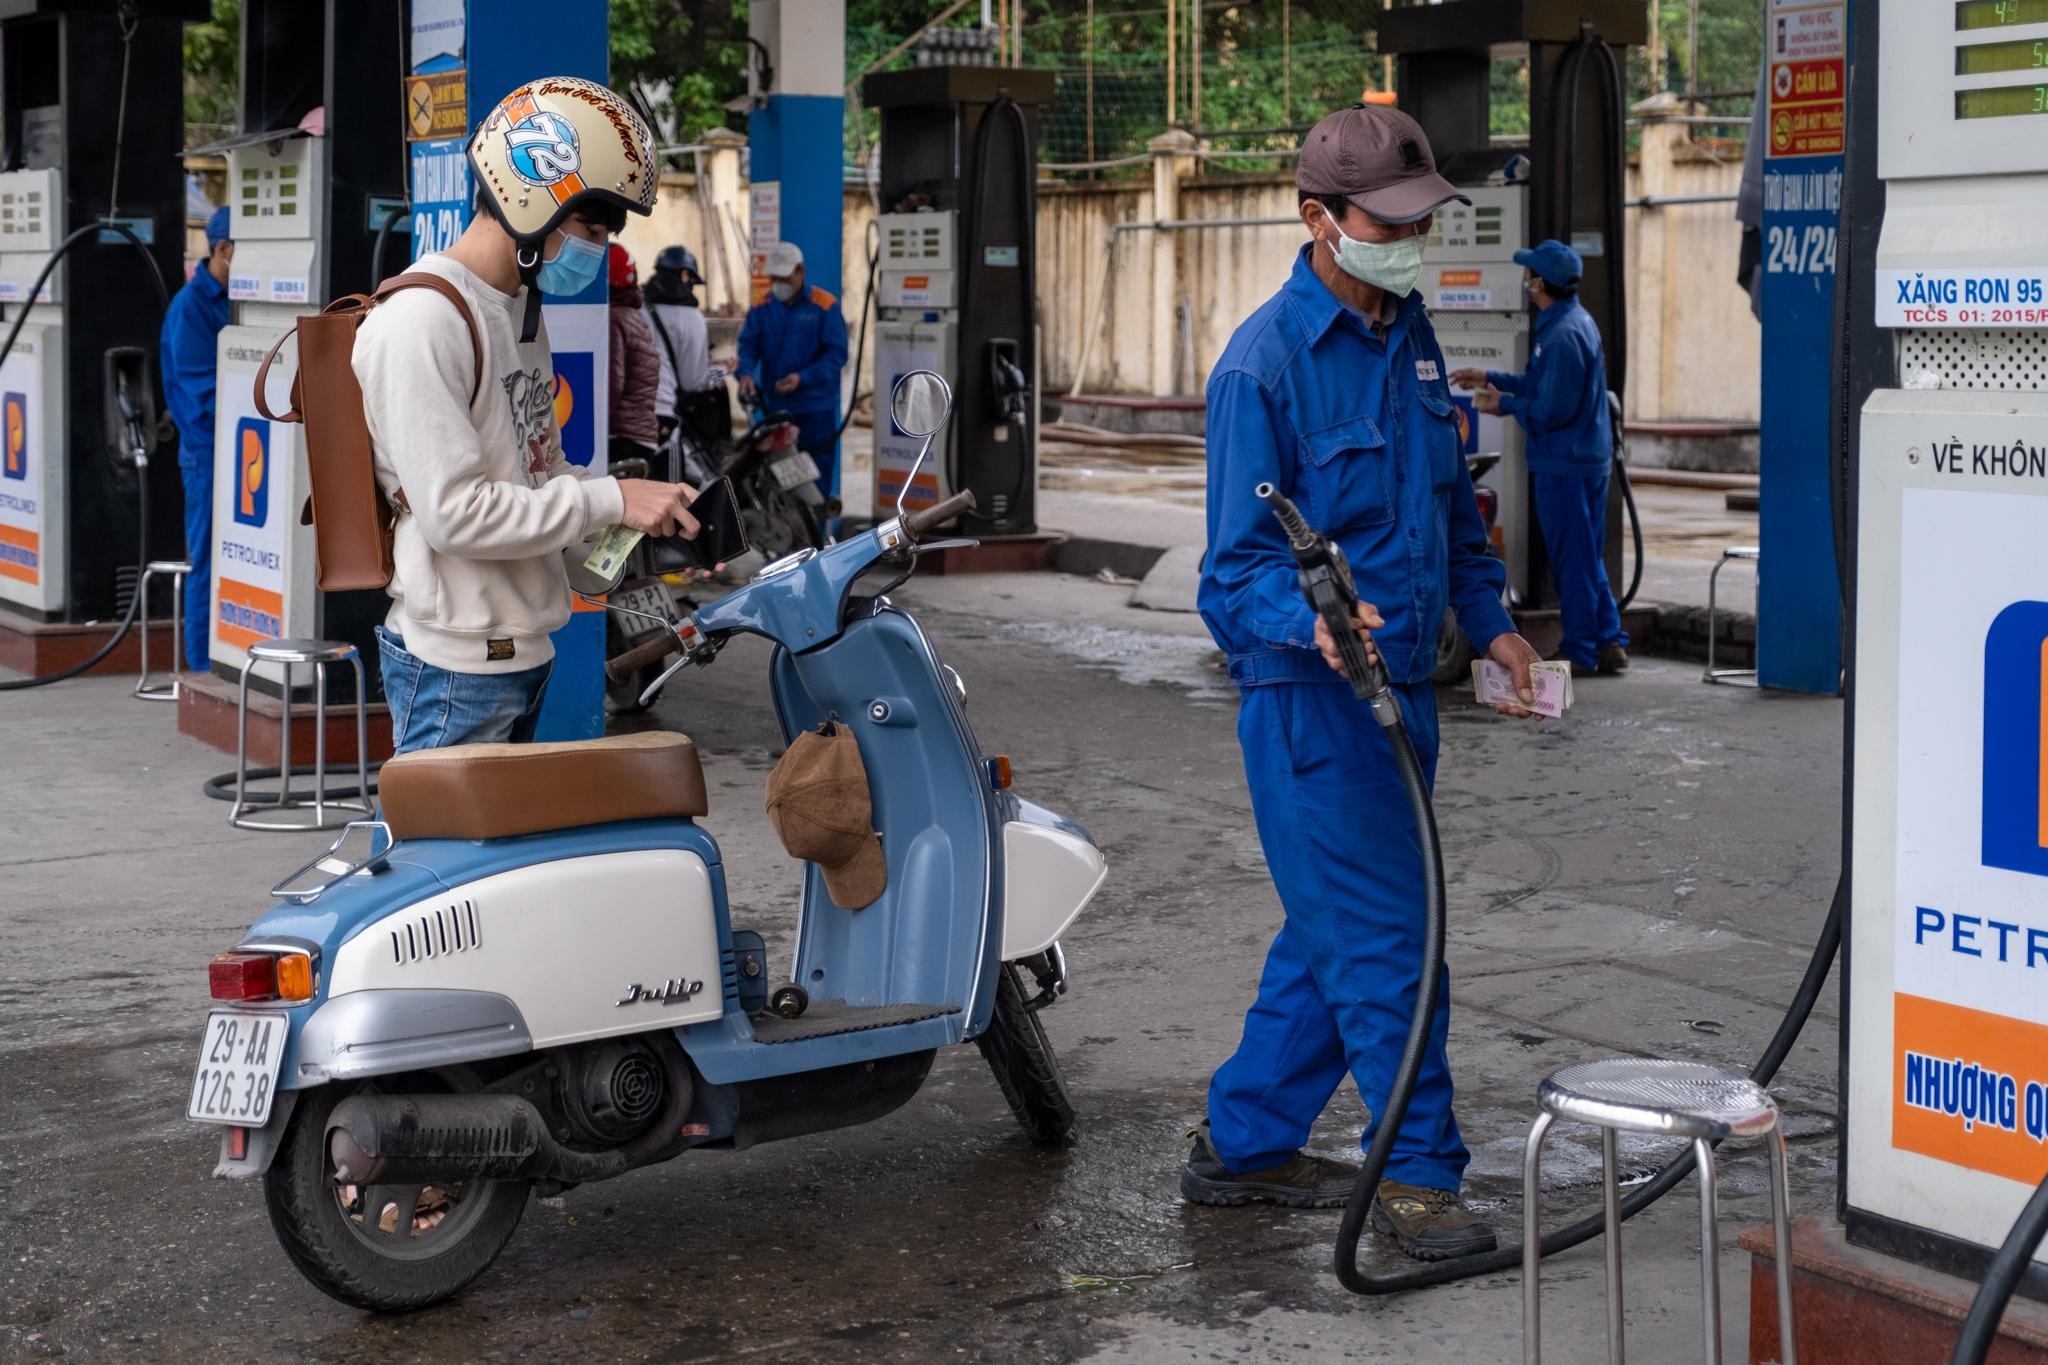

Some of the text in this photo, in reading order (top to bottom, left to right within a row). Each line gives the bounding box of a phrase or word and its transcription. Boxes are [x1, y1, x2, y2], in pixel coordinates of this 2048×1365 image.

[1783, 173, 1803, 211] GIAN
[1767, 225, 1838, 275] 24/24
[1897, 273, 2043, 304] XĂNG RON 95
[1904, 310, 1948, 322] TCCS
[1959, 310, 1985, 322] 01:
[1932, 435, 1964, 474] VỀ
[222, 540, 280, 571] PETROLIMEX
[1915, 905, 2048, 969] PETR
[615, 977, 704, 1007] Julio
[197, 1068, 270, 1117] 126.38
[1905, 1050, 2048, 1144] NHƯỢNG Q
